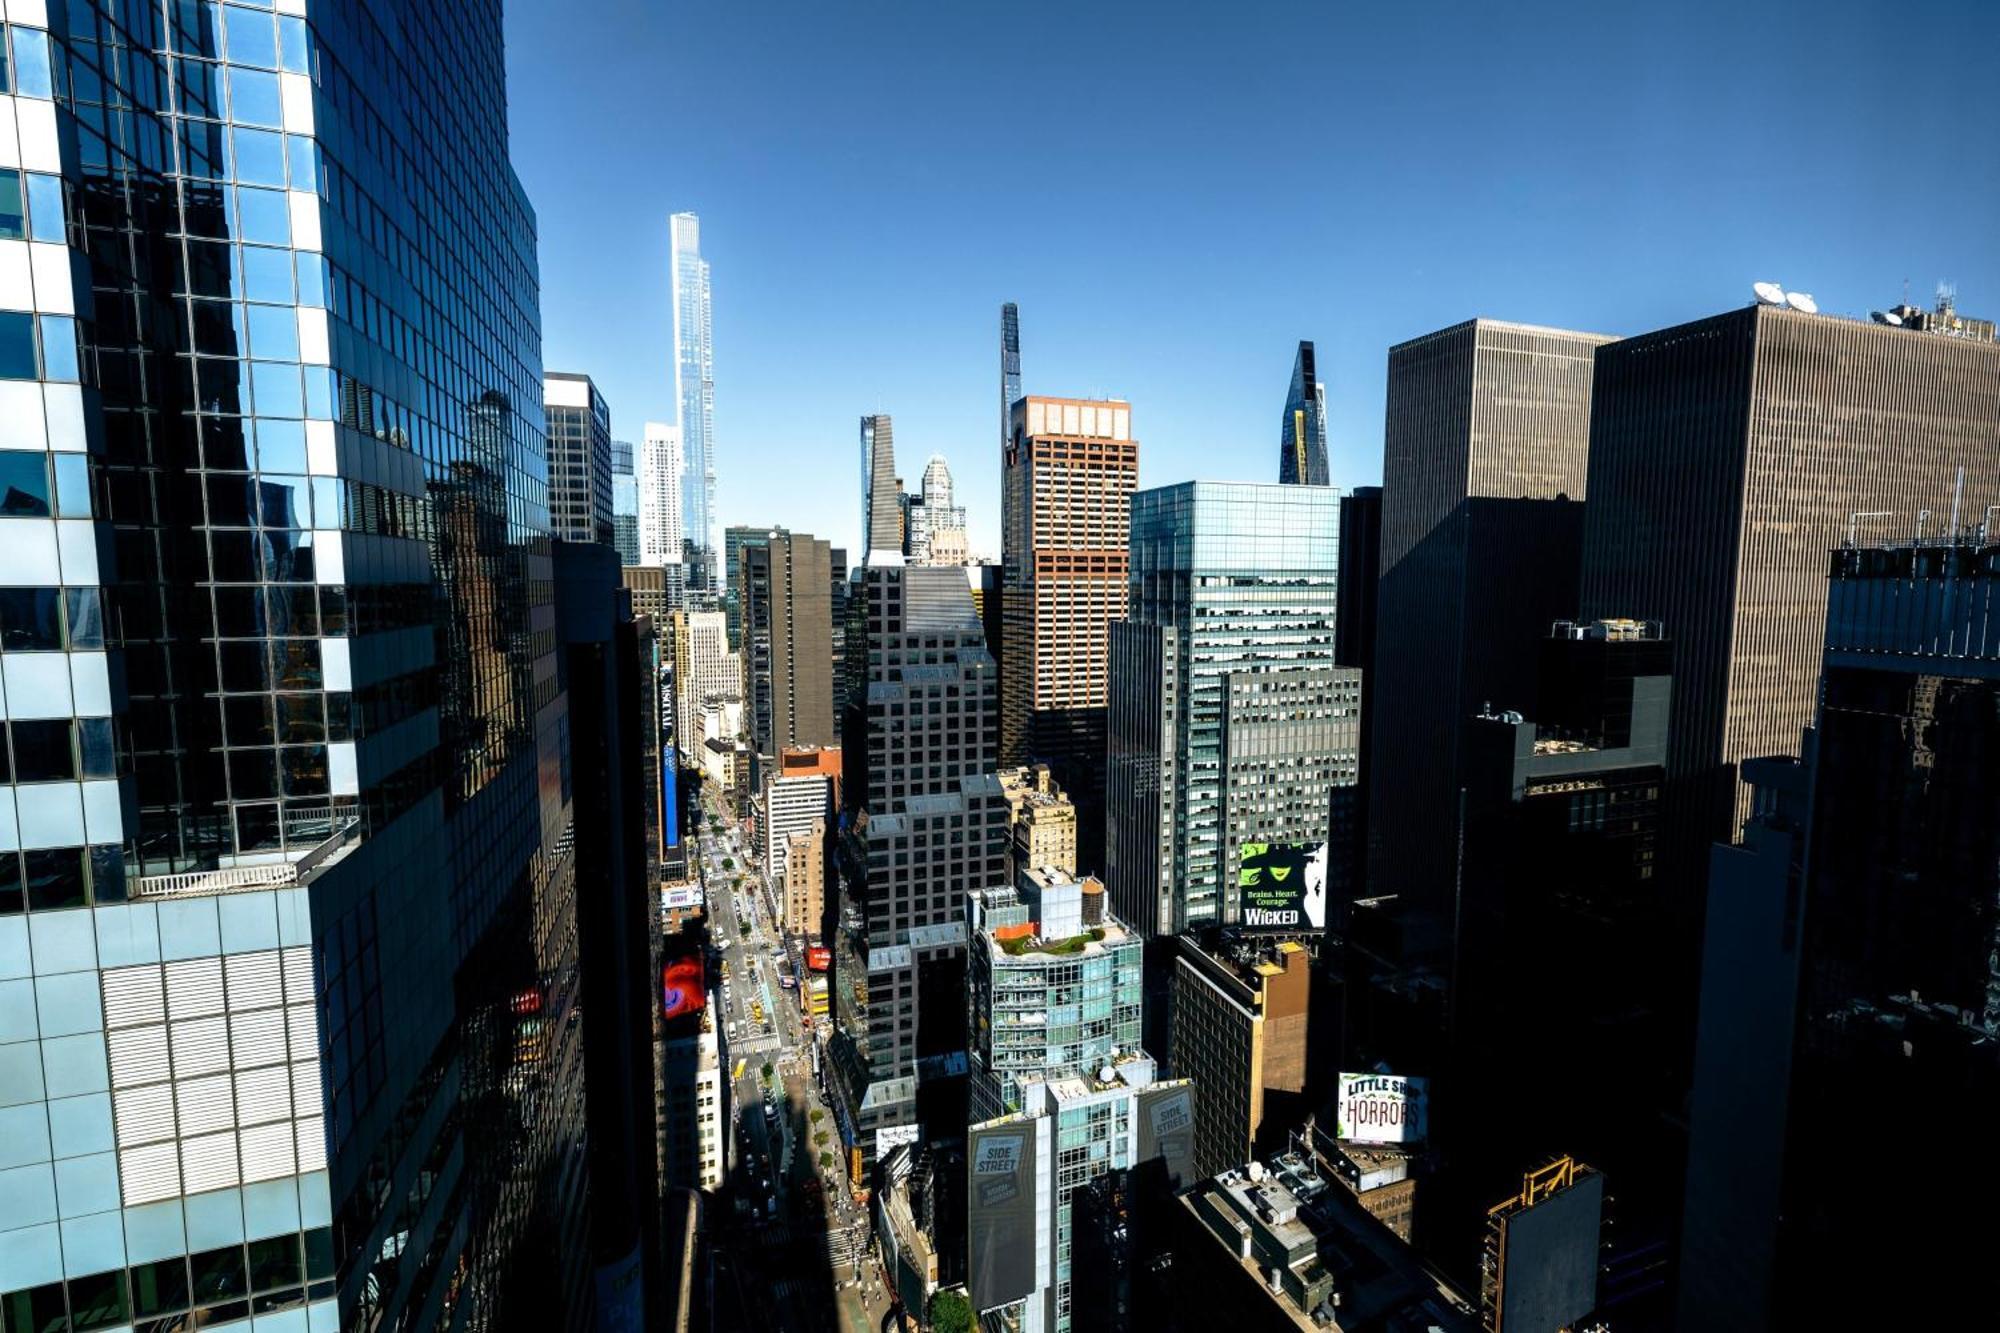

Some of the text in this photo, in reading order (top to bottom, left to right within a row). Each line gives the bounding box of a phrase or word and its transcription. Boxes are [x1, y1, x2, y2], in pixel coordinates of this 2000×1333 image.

[1275, 890, 1299, 898] Heart.
[1348, 1078, 1421, 1099] LITTLE SHOP
[1160, 1105, 1182, 1121] SIDE
[1347, 1099, 1419, 1137] HORRORS
[1157, 1113, 1188, 1134] STREET
[986, 1147, 1012, 1159] SIDE
[978, 1159, 1016, 1172] STREET
